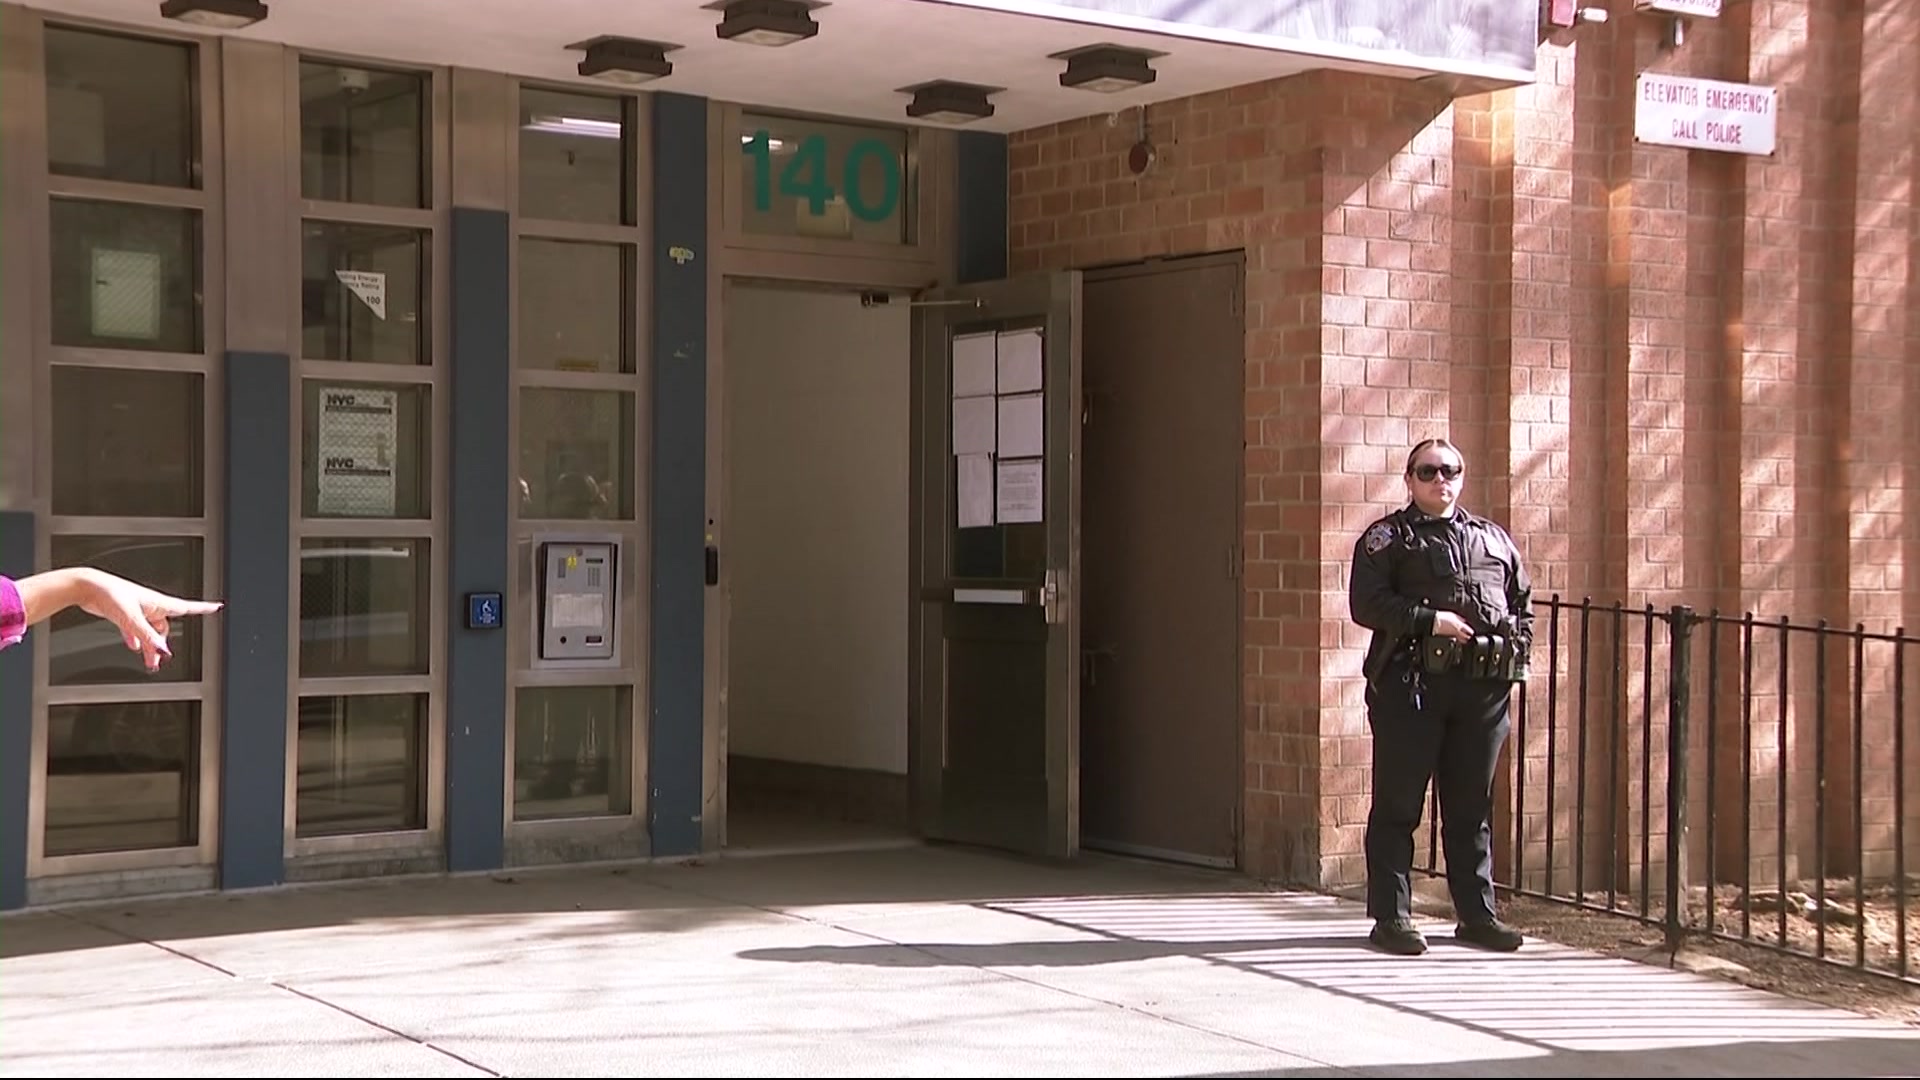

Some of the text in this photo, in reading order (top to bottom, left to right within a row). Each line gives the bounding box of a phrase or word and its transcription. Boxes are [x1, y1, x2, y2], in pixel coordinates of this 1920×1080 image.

[1644, 82, 1769, 114] ELEVATOR EMERGENCY
[1672, 118, 1742, 144] CALL POLICE
[742, 129, 899, 222] 140
[366, 296, 381, 305] 100
